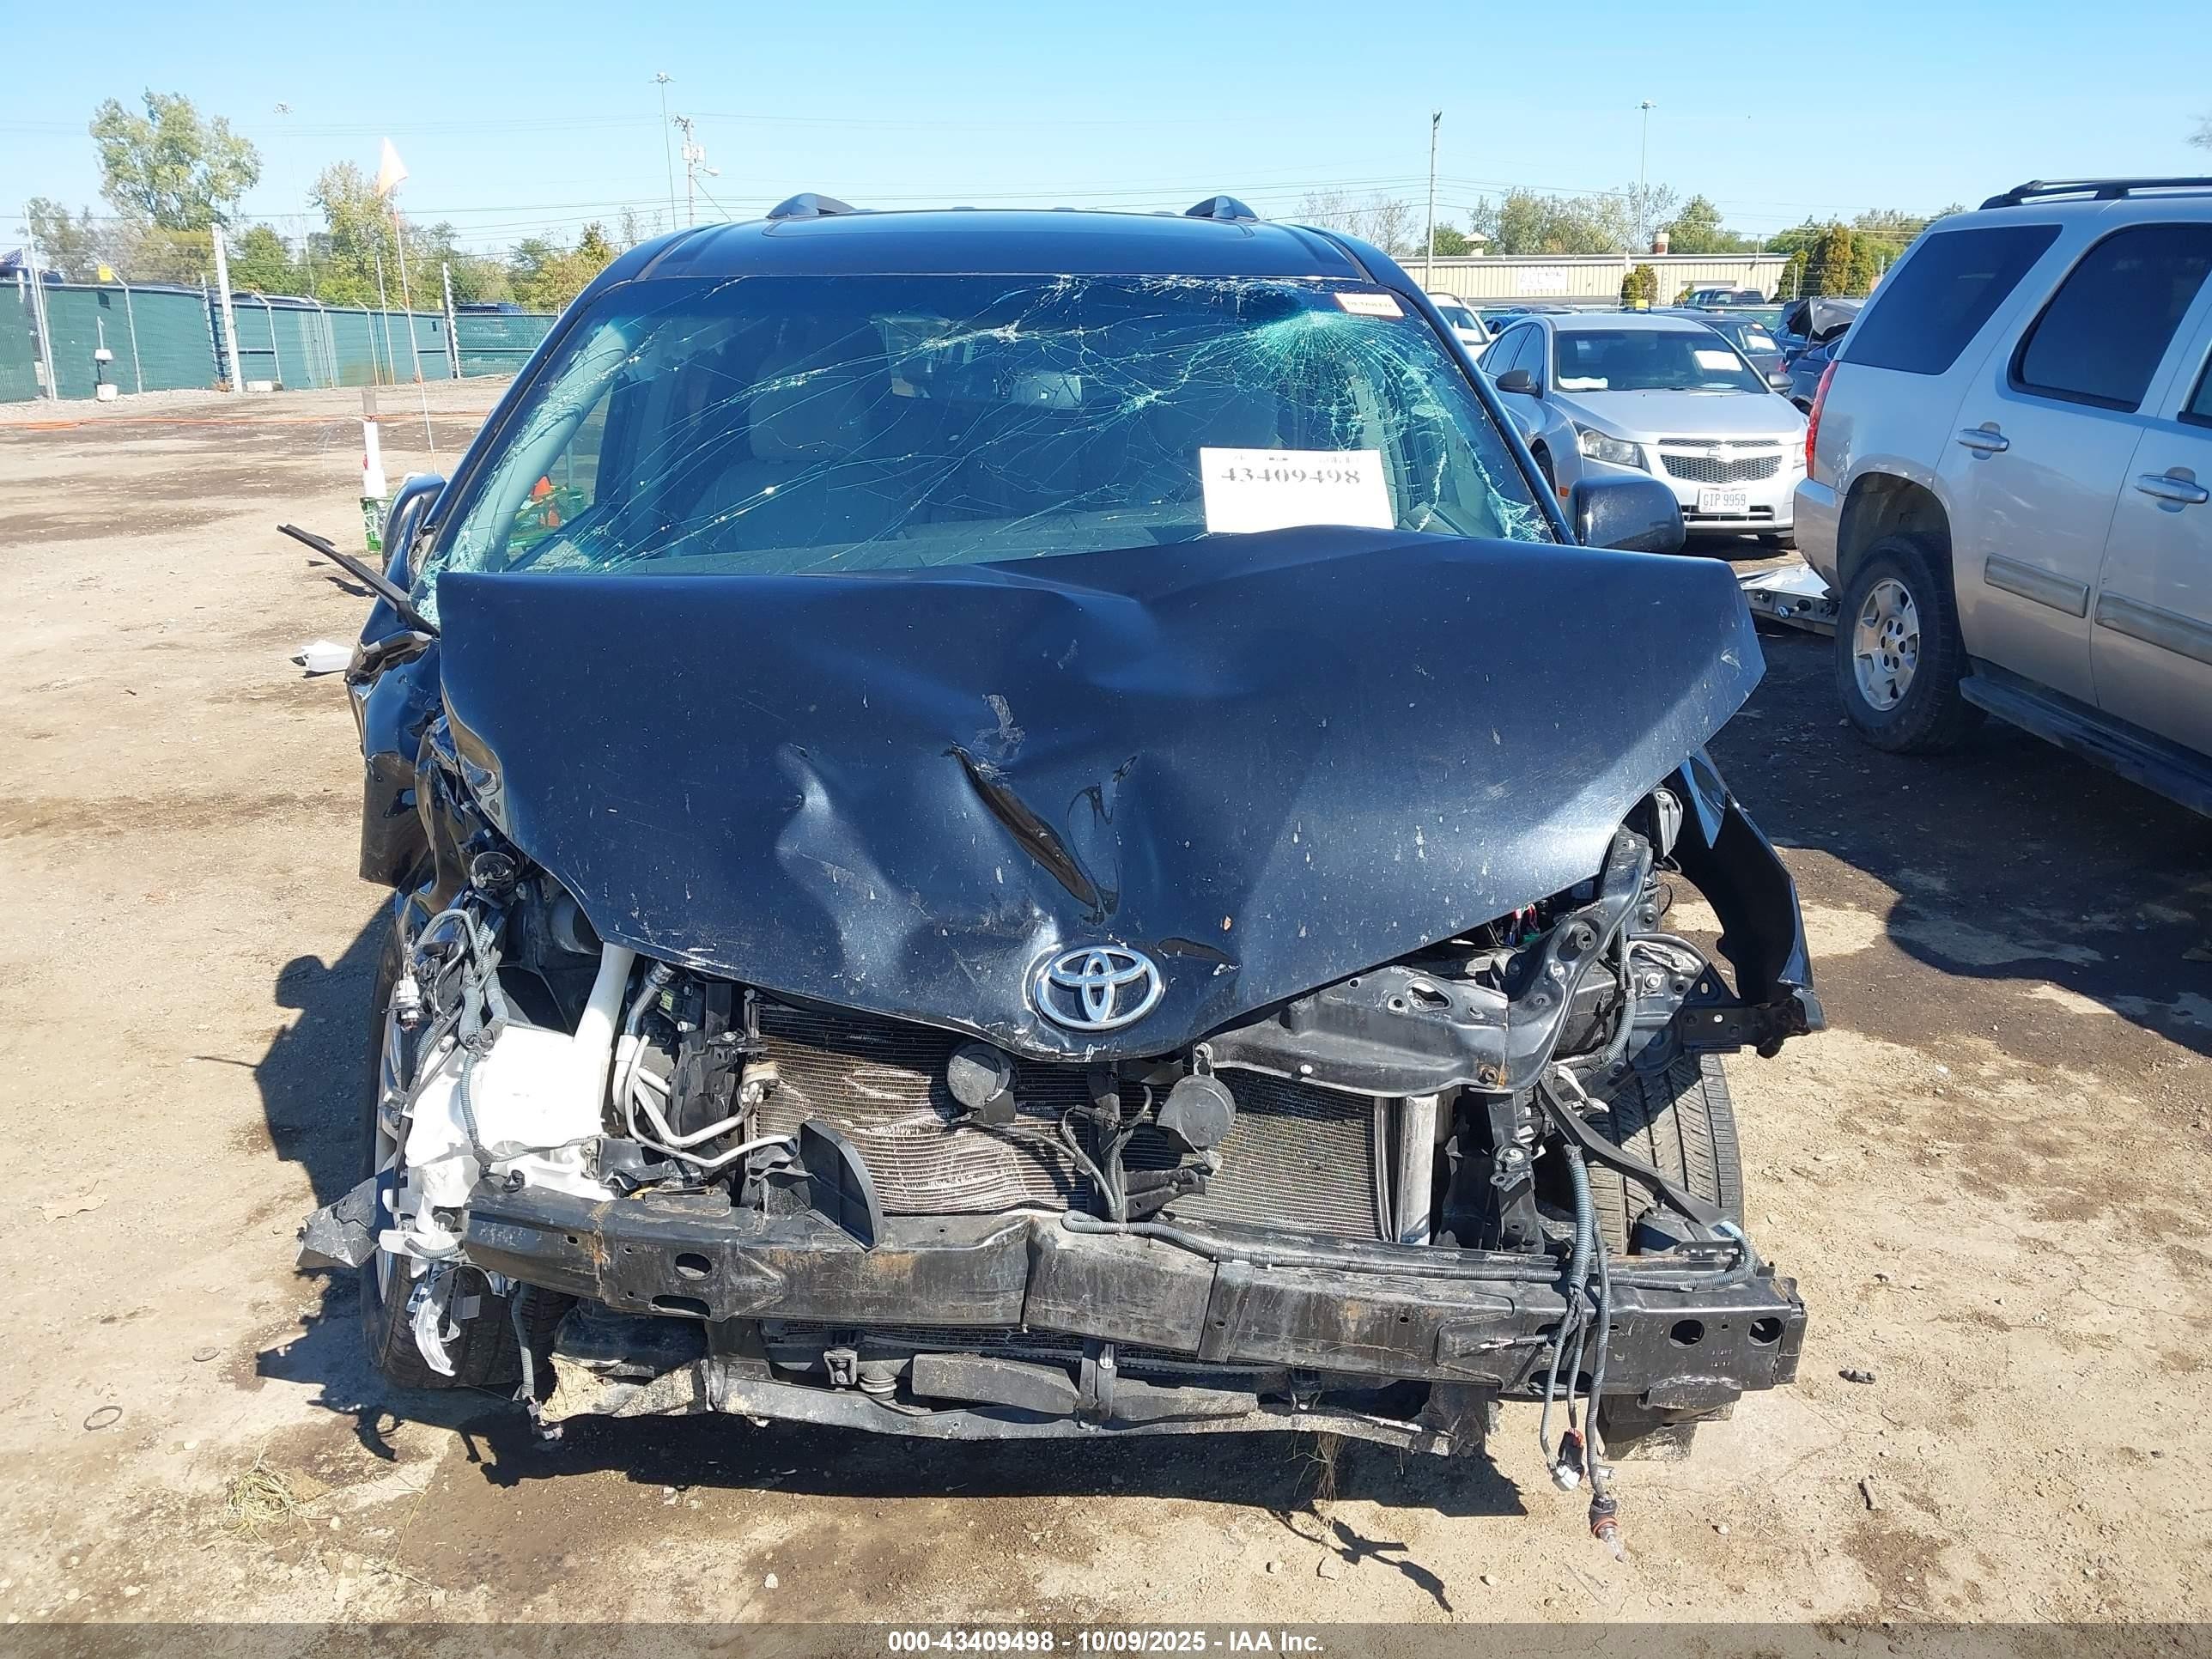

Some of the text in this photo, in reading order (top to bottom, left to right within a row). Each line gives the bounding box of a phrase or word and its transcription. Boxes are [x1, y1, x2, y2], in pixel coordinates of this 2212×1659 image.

[1221, 467, 1361, 484] 43409498
[1703, 494, 1746, 506] GIP 9959
